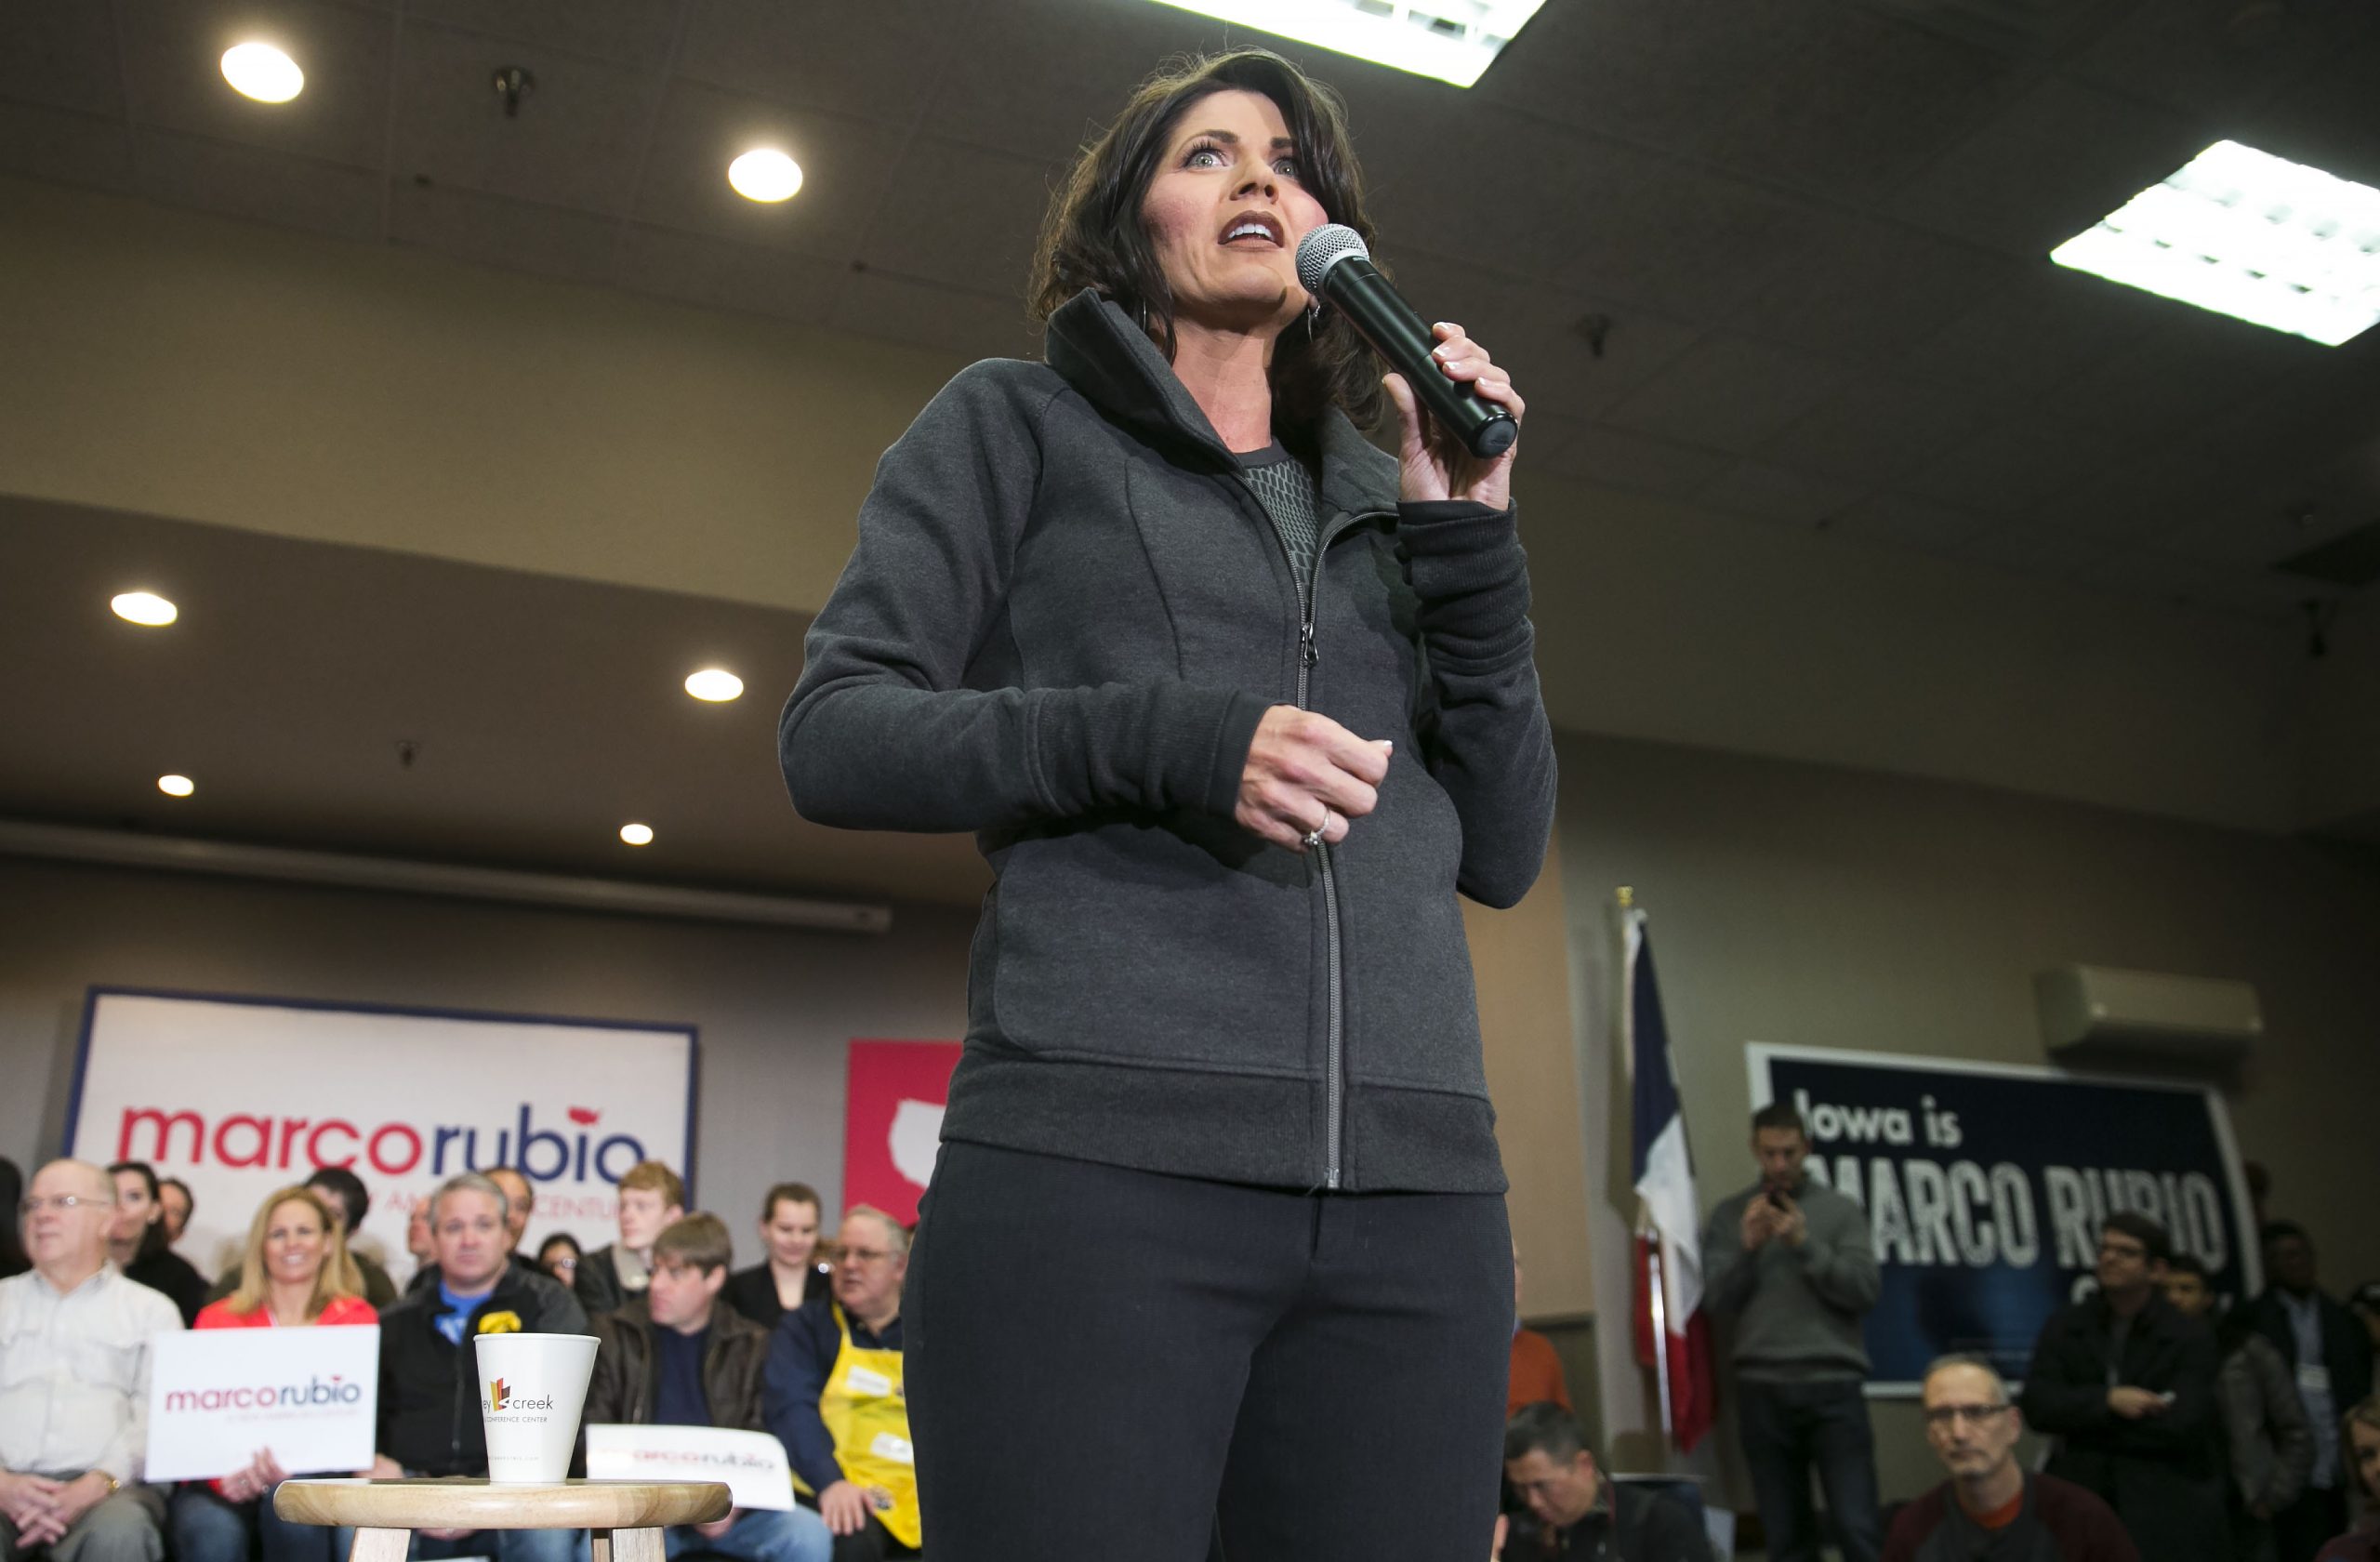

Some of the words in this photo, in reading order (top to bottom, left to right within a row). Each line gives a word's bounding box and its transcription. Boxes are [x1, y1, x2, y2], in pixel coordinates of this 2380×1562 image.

[1793, 1088, 1913, 1145] Iowa
[1921, 1093, 1963, 1148] is
[512, 1395, 554, 1410] creek
